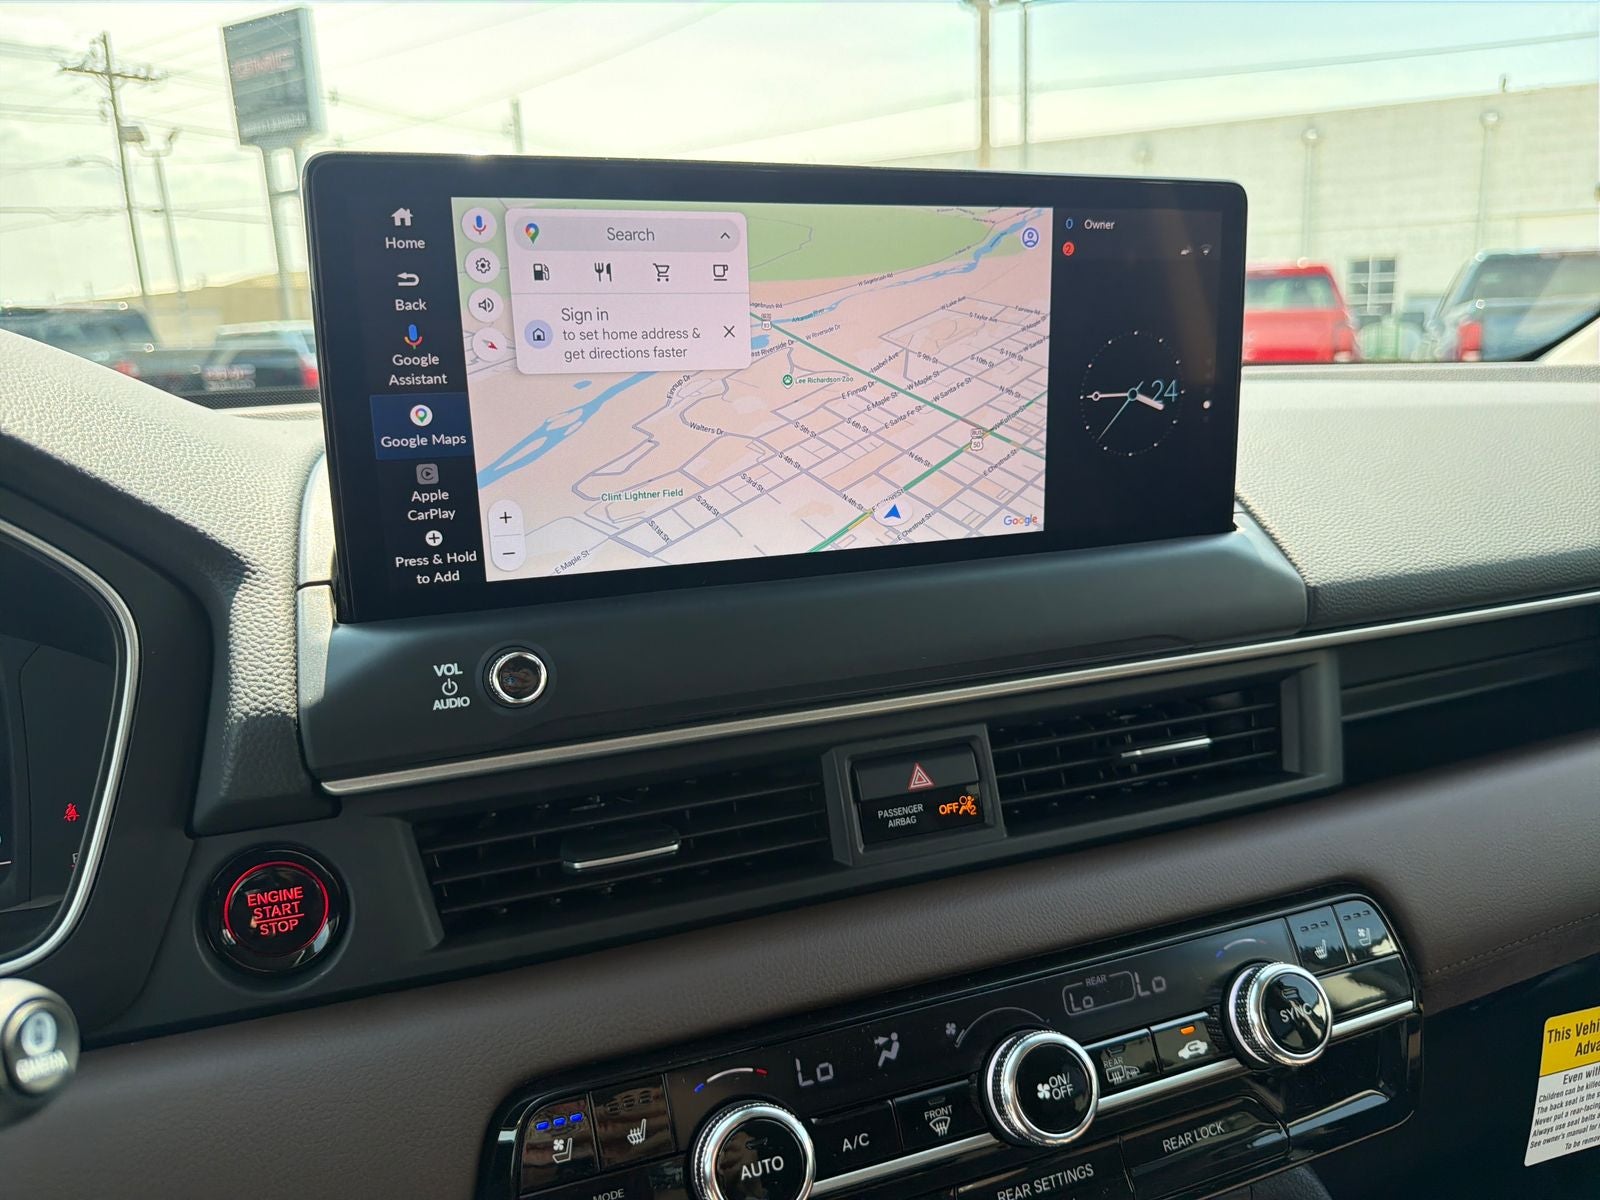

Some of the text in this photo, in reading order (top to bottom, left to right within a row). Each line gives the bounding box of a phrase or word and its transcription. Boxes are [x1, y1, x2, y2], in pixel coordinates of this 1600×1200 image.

[1084, 219, 1115, 230] Owner
[606, 227, 655, 242] Search
[385, 237, 426, 250] Home
[395, 299, 426, 311] Back
[561, 307, 609, 324] Sign in
[563, 327, 701, 340] to set home address &
[392, 354, 440, 368] Google
[564, 346, 688, 363] get directions faster
[976, 356, 988, 366] 10th
[1006, 350, 1016, 360] 11th
[870, 352, 899, 374] Isabel Ave
[389, 373, 448, 386] Assistant
[913, 373, 932, 388] Maple
[667, 379, 683, 398] Finnup
[846, 384, 868, 398] Finnup
[940, 385, 956, 398] Santa
[1005, 386, 1014, 396] 9th
[1151, 379, 1178, 404] 24
[871, 396, 890, 410] Maple
[889, 414, 906, 427] Santa
[906, 410, 914, 418] Fe
[915, 405, 922, 413] St
[690, 422, 716, 434] Walters
[800, 424, 809, 434] 5th
[852, 419, 862, 429] 6th
[380, 434, 466, 448] Google Maps
[784, 454, 793, 465] 4th
[794, 462, 800, 470] St
[914, 454, 923, 464] 6th
[746, 476, 756, 487] 3rd
[756, 484, 764, 492] St
[411, 489, 449, 502] Apple
[601, 488, 684, 502] Clint Lightner Field
[701, 498, 712, 510] 2nd
[712, 508, 720, 516] St
[848, 496, 856, 506] 4th
[857, 502, 864, 510] St
[407, 508, 456, 521] CarPlay
[1003, 514, 1038, 526] Google
[902, 518, 924, 536] Chestnut
[925, 512, 932, 520] St
[654, 524, 664, 536] 1st
[663, 534, 670, 543] St
[395, 551, 477, 568] Press & Hold
[560, 554, 582, 572] Maple
[582, 550, 590, 559] St
[416, 570, 460, 584] to Add
[433, 662, 463, 677] VOL
[432, 696, 470, 710] AUDIO
[878, 803, 924, 819] PASSENGER
[938, 802, 959, 815] OFF
[888, 815, 917, 828] AIRBAG
[248, 886, 304, 907] ENGINE
[254, 901, 301, 920] START
[260, 919, 298, 936] STOP
[1085, 974, 1107, 986] REAR
[1134, 972, 1167, 997] Lo
[1069, 992, 1094, 1012] Lo
[1280, 1002, 1313, 1024] SYNC
[1548, 1026, 1572, 1044] This
[1103, 1056, 1124, 1068] REAR
[796, 1058, 834, 1087] Lo
[1048, 1072, 1070, 1087] ON/
[1562, 1072, 1583, 1085] Even
[1052, 1084, 1074, 1100] OFF
[1538, 1090, 1564, 1102] Children
[1577, 1084, 1584, 1092] be
[1536, 1106, 1548, 1114] The
[1550, 1100, 1564, 1111] back
[1565, 1097, 1578, 1106] seat
[1586, 1092, 1596, 1100] the
[924, 1104, 953, 1121] FRONT
[1534, 1116, 1552, 1126] Never
[1554, 1112, 1564, 1122] put
[1532, 1126, 1554, 1138] Always
[1567, 1118, 1580, 1128] seat
[1581, 1114, 1596, 1123] belts
[842, 1132, 870, 1152] A/C
[1162, 1122, 1225, 1152] REAR LOCK
[1530, 1140, 1541, 1148] See
[1542, 1133, 1566, 1144] owner's
[1566, 1126, 1588, 1138] manual
[1589, 1123, 1598, 1132] for
[1573, 1140, 1580, 1148] be
[740, 1156, 784, 1181] AUTO
[998, 1163, 1094, 1200] REAR SETTINGS
